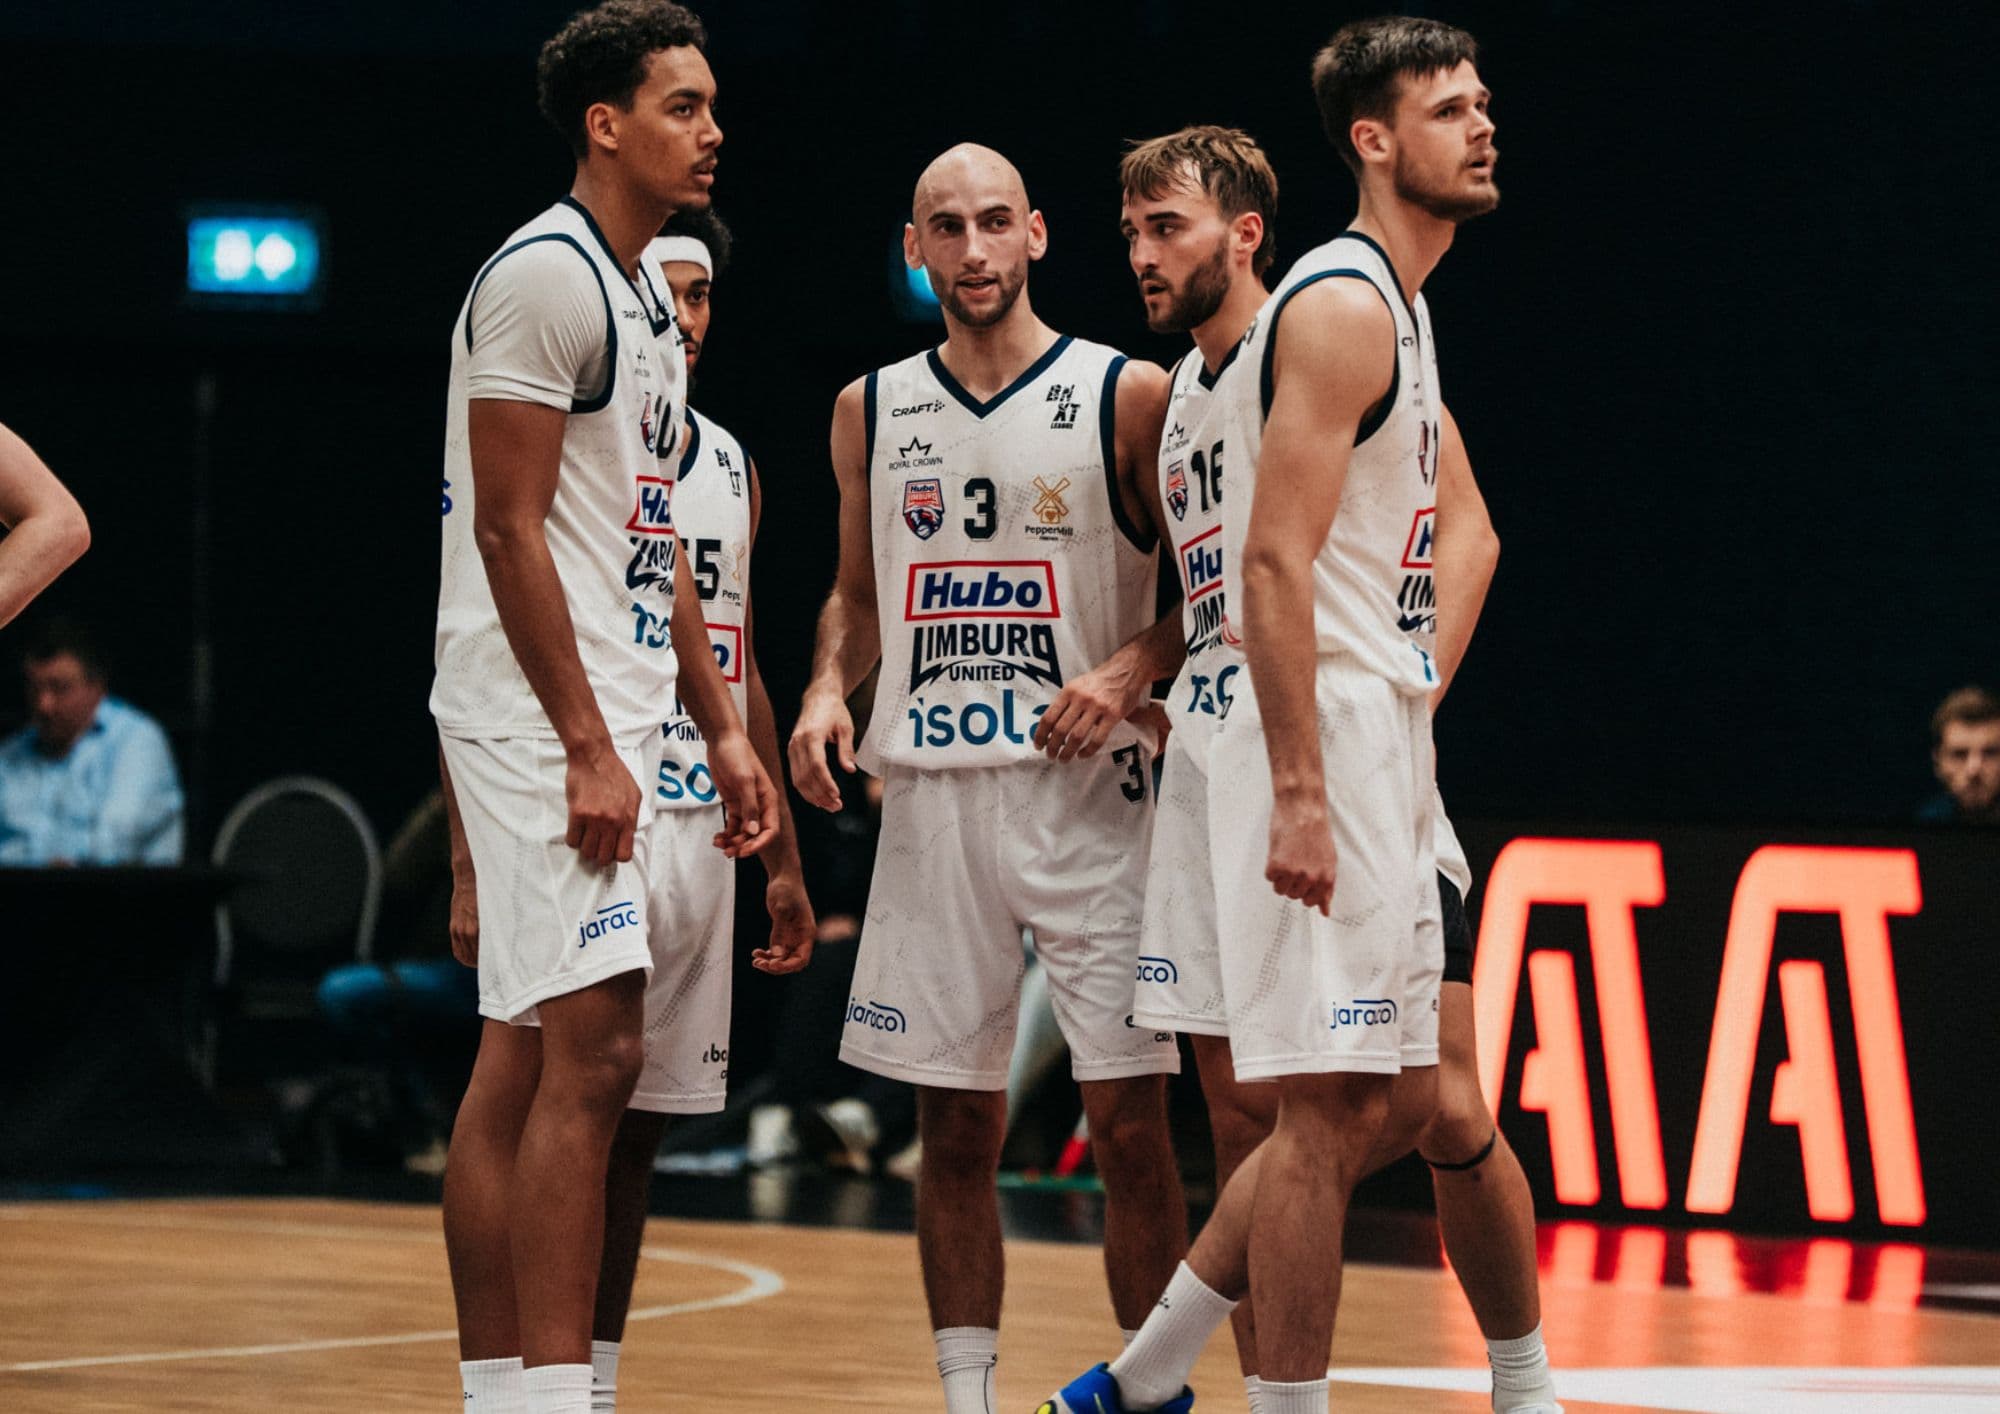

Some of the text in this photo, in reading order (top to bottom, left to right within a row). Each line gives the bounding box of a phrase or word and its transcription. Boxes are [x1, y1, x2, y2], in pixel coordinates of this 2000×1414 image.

[892, 403, 933, 417] CRAFT
[889, 457, 943, 471] ROYAL CROWN
[964, 478, 996, 540] 3
[1025, 525, 1073, 537] PepperMill
[682, 538, 722, 601] 5
[921, 572, 1042, 609] Hubo
[910, 623, 1063, 695] LIMBURG
[950, 665, 1015, 682] UNITED
[1112, 743, 1146, 804] 3
